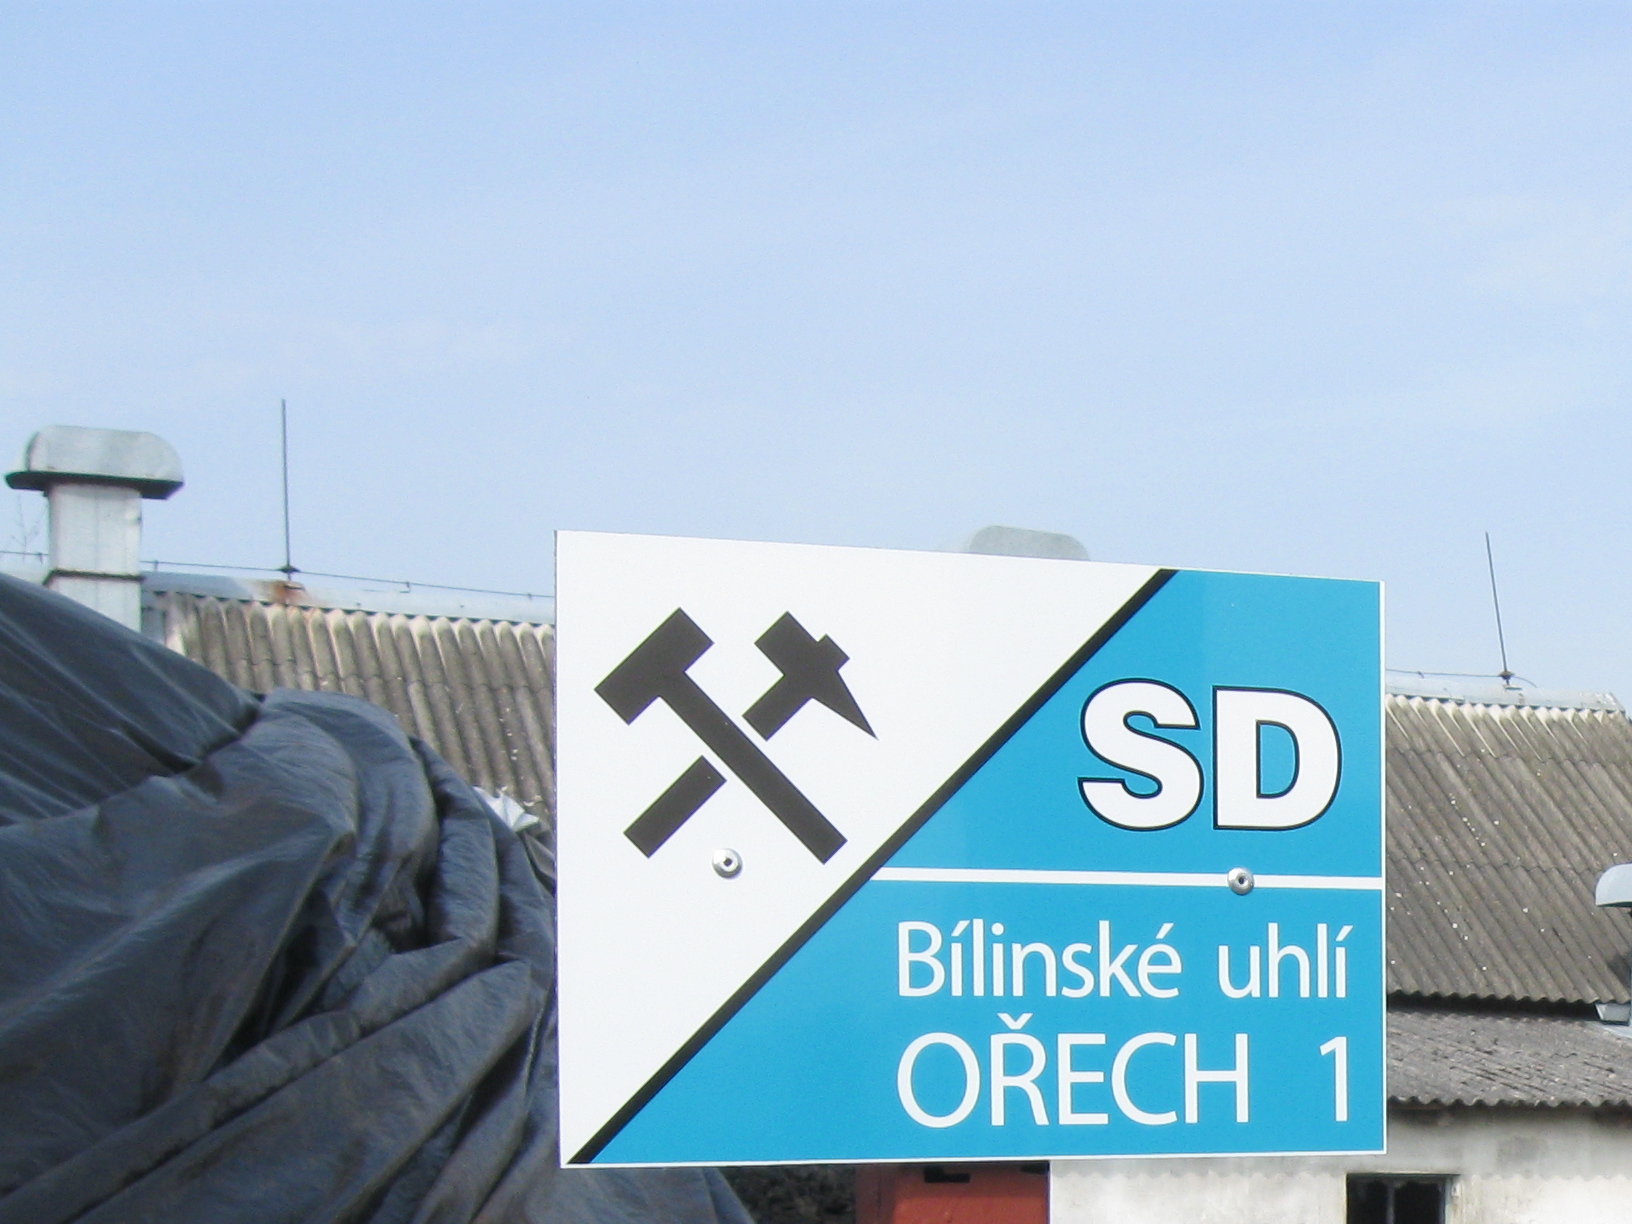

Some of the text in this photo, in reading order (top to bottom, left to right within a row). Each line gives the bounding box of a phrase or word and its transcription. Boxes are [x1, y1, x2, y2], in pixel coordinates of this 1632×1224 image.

[1077, 677, 1343, 832] SD
[898, 918, 1354, 998] Bílinské uhlí
[896, 1012, 1348, 1129] OŘECH 1
